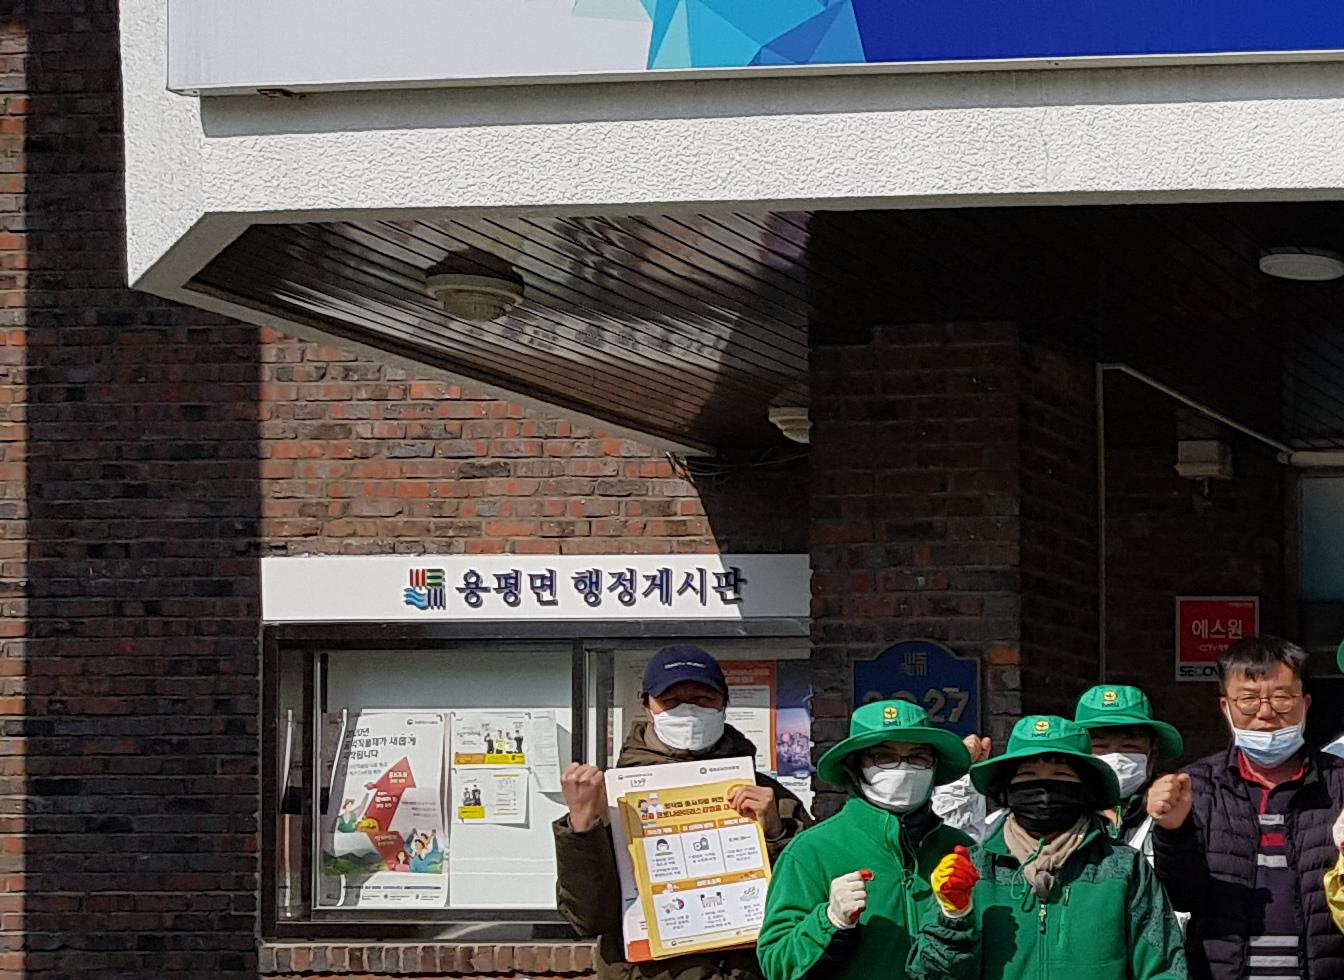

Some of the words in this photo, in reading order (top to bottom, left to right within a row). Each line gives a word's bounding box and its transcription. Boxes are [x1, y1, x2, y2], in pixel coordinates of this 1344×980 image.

[455, 567, 559, 608] 용평면
[571, 566, 749, 607] 행정게시판
[1191, 618, 1244, 640] 에스원
